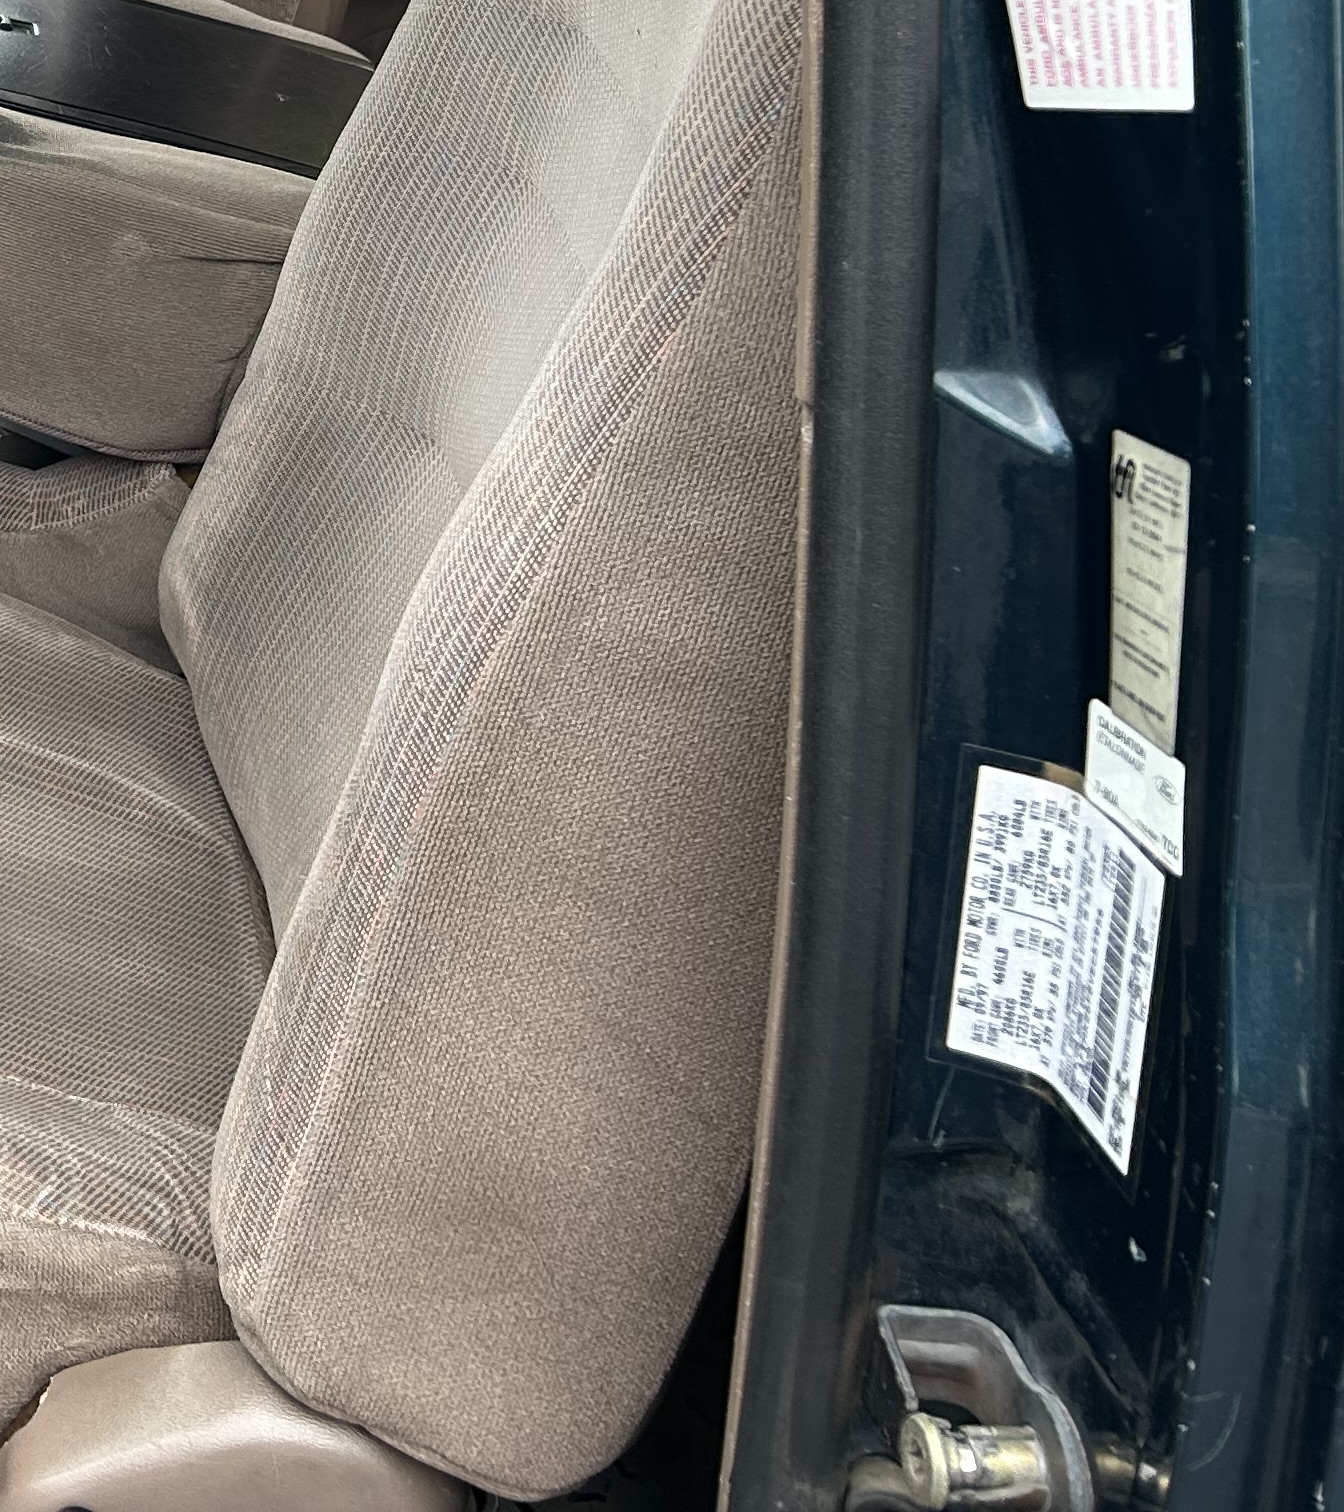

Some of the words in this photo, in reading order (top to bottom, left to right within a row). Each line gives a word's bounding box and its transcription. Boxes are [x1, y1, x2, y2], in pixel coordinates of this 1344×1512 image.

[1016, 1, 1032, 52] VEHICLE
[1052, 13, 1062, 23] IS
[1055, 30, 1067, 55] AND
[1107, 12, 1123, 86] WARRANTY
[1026, 59, 1037, 85] THIS
[1041, 51, 1054, 86] FORD
[1095, 68, 1105, 85] AN
[1096, 715, 1147, 760] CALIBRATION
[974, 850, 991, 863] IN
[966, 897, 985, 927] MOTOR
[963, 933, 982, 958] FORD
[961, 964, 977, 976] BY
